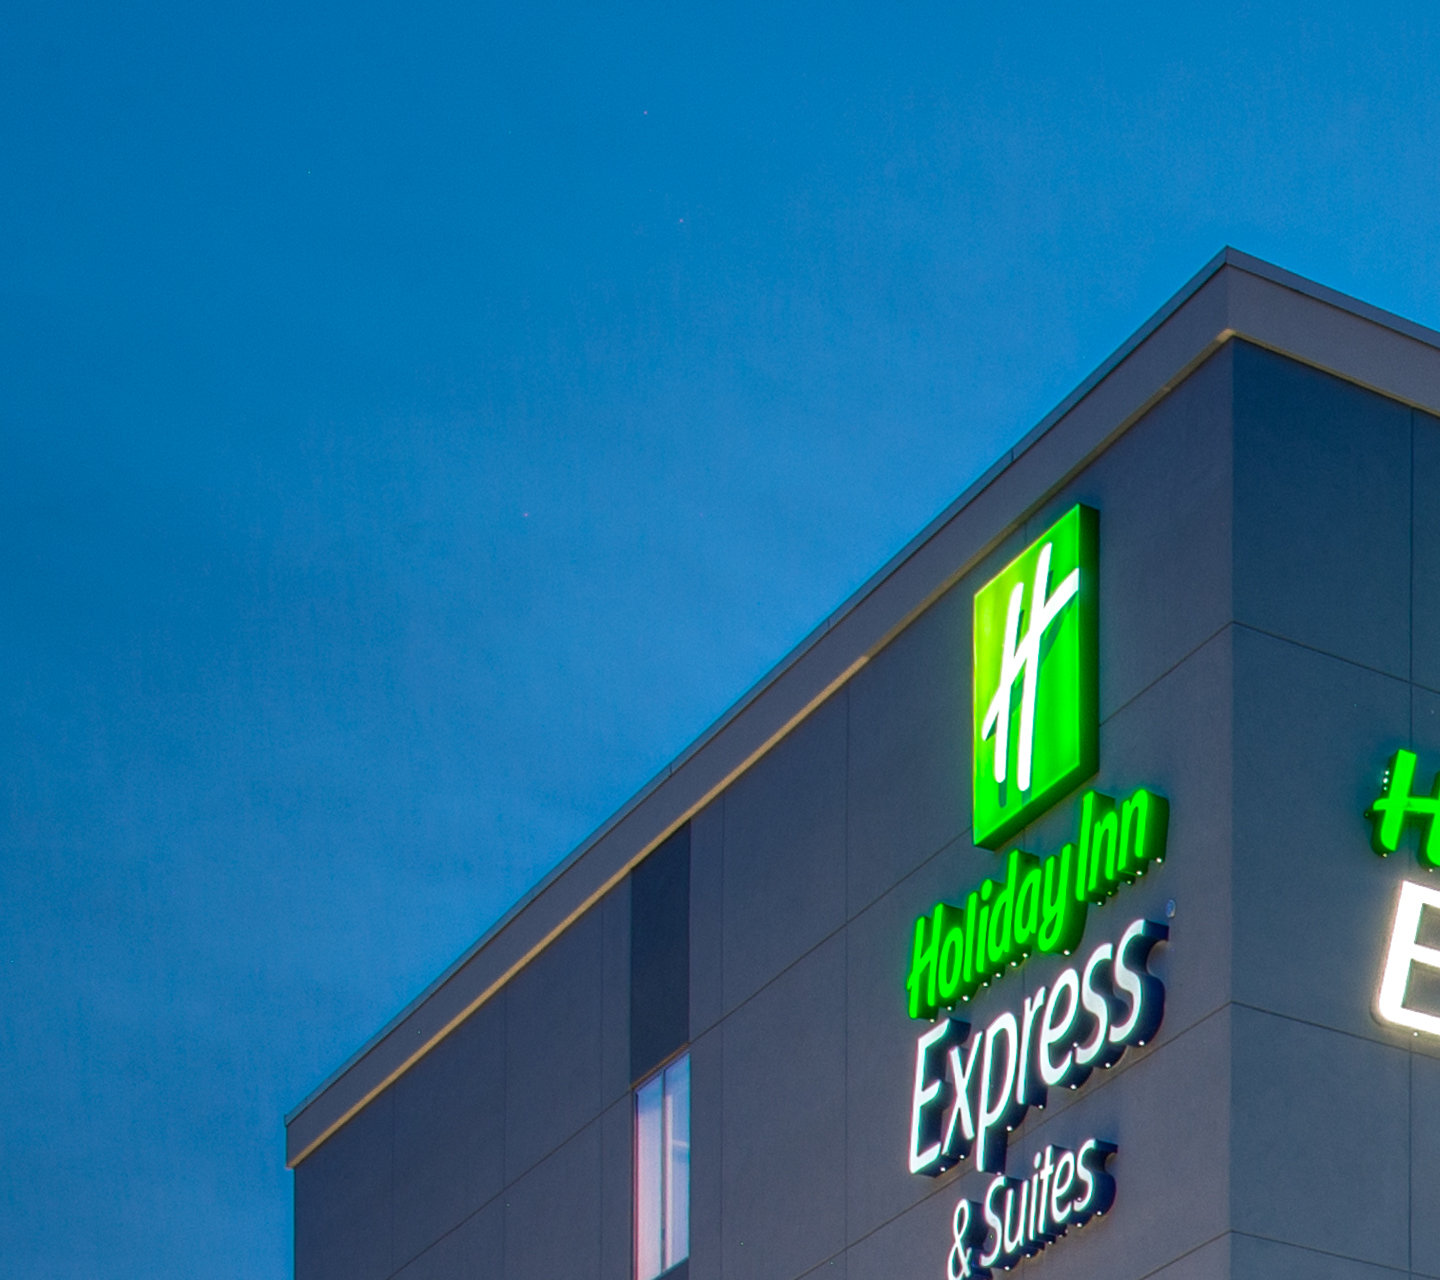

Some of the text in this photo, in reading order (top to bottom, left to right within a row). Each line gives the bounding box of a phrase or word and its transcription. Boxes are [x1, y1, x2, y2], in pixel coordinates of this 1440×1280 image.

[908, 789, 1149, 1020] Holiday Inn
[908, 920, 1146, 1174] Express
[982, 1137, 1099, 1259] Suites
